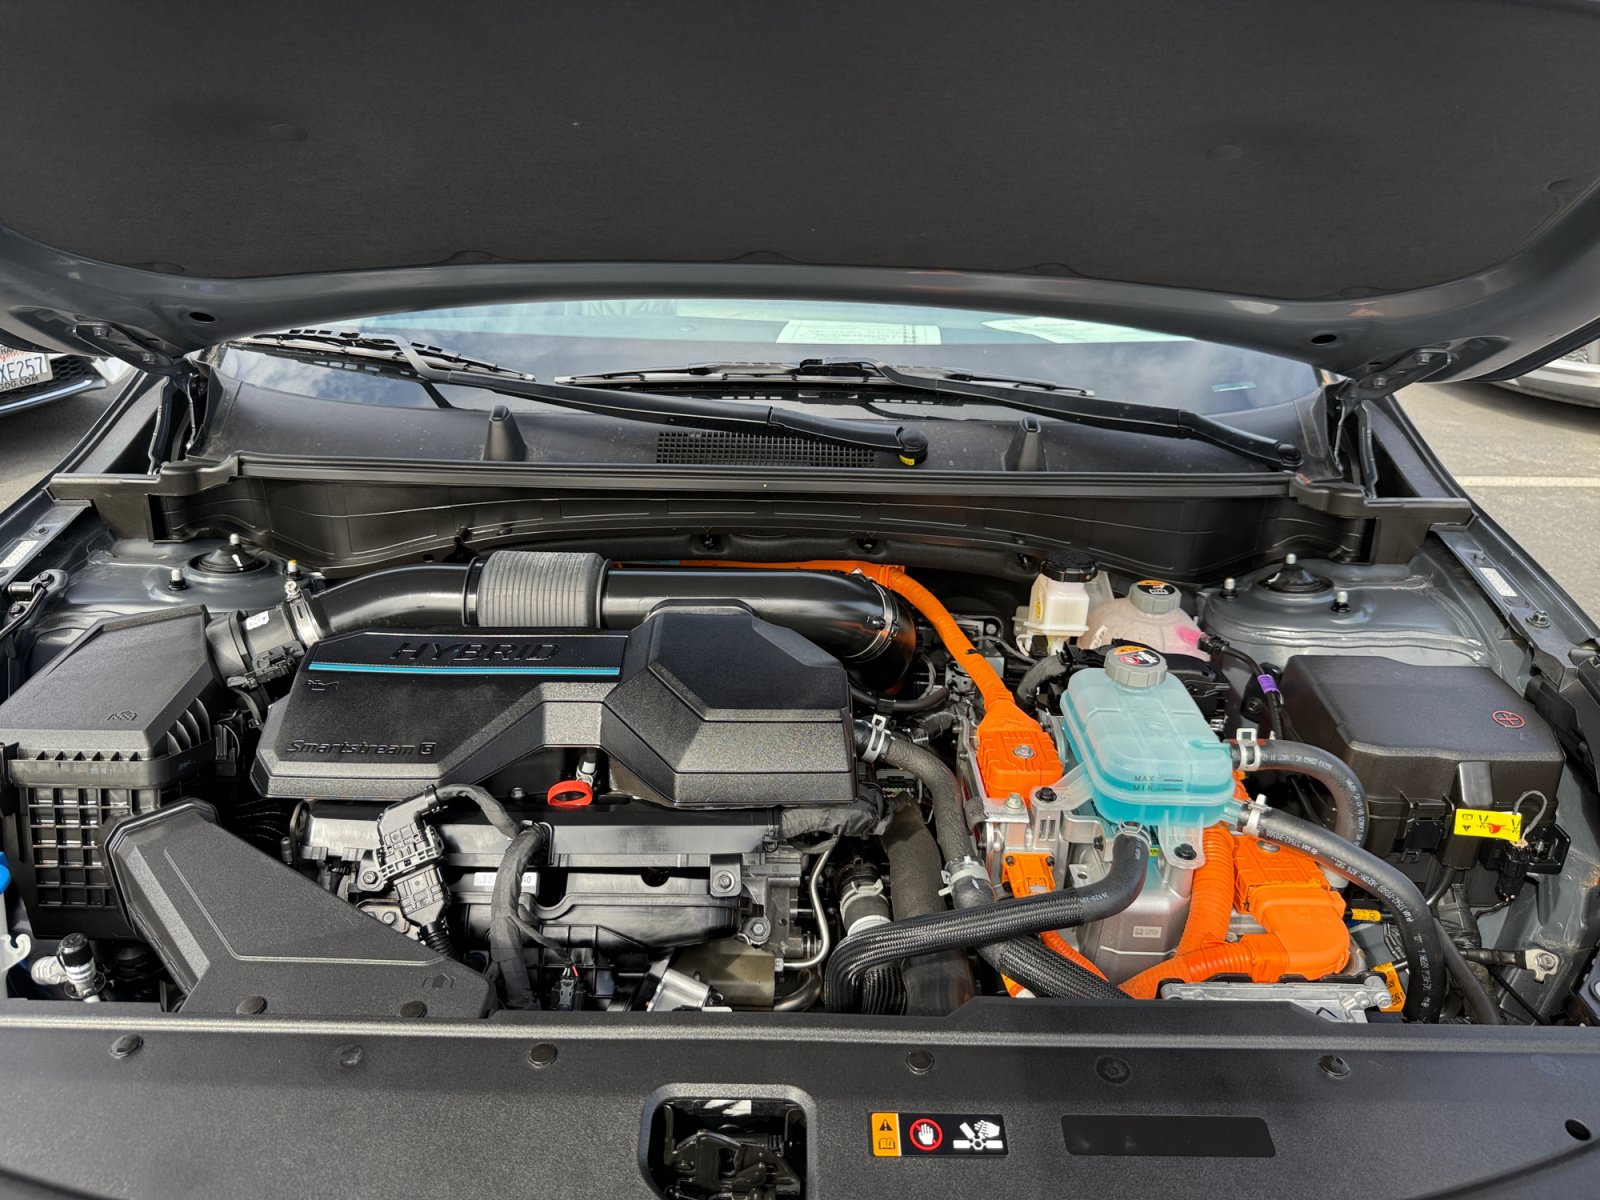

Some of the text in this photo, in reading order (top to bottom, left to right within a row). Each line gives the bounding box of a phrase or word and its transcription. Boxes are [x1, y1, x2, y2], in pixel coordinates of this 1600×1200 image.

[389, 642, 560, 661] HYBRID
[286, 739, 415, 754] Smartstream
[1134, 775, 1154, 783] MAX
[1132, 783, 1153, 792] MIN
